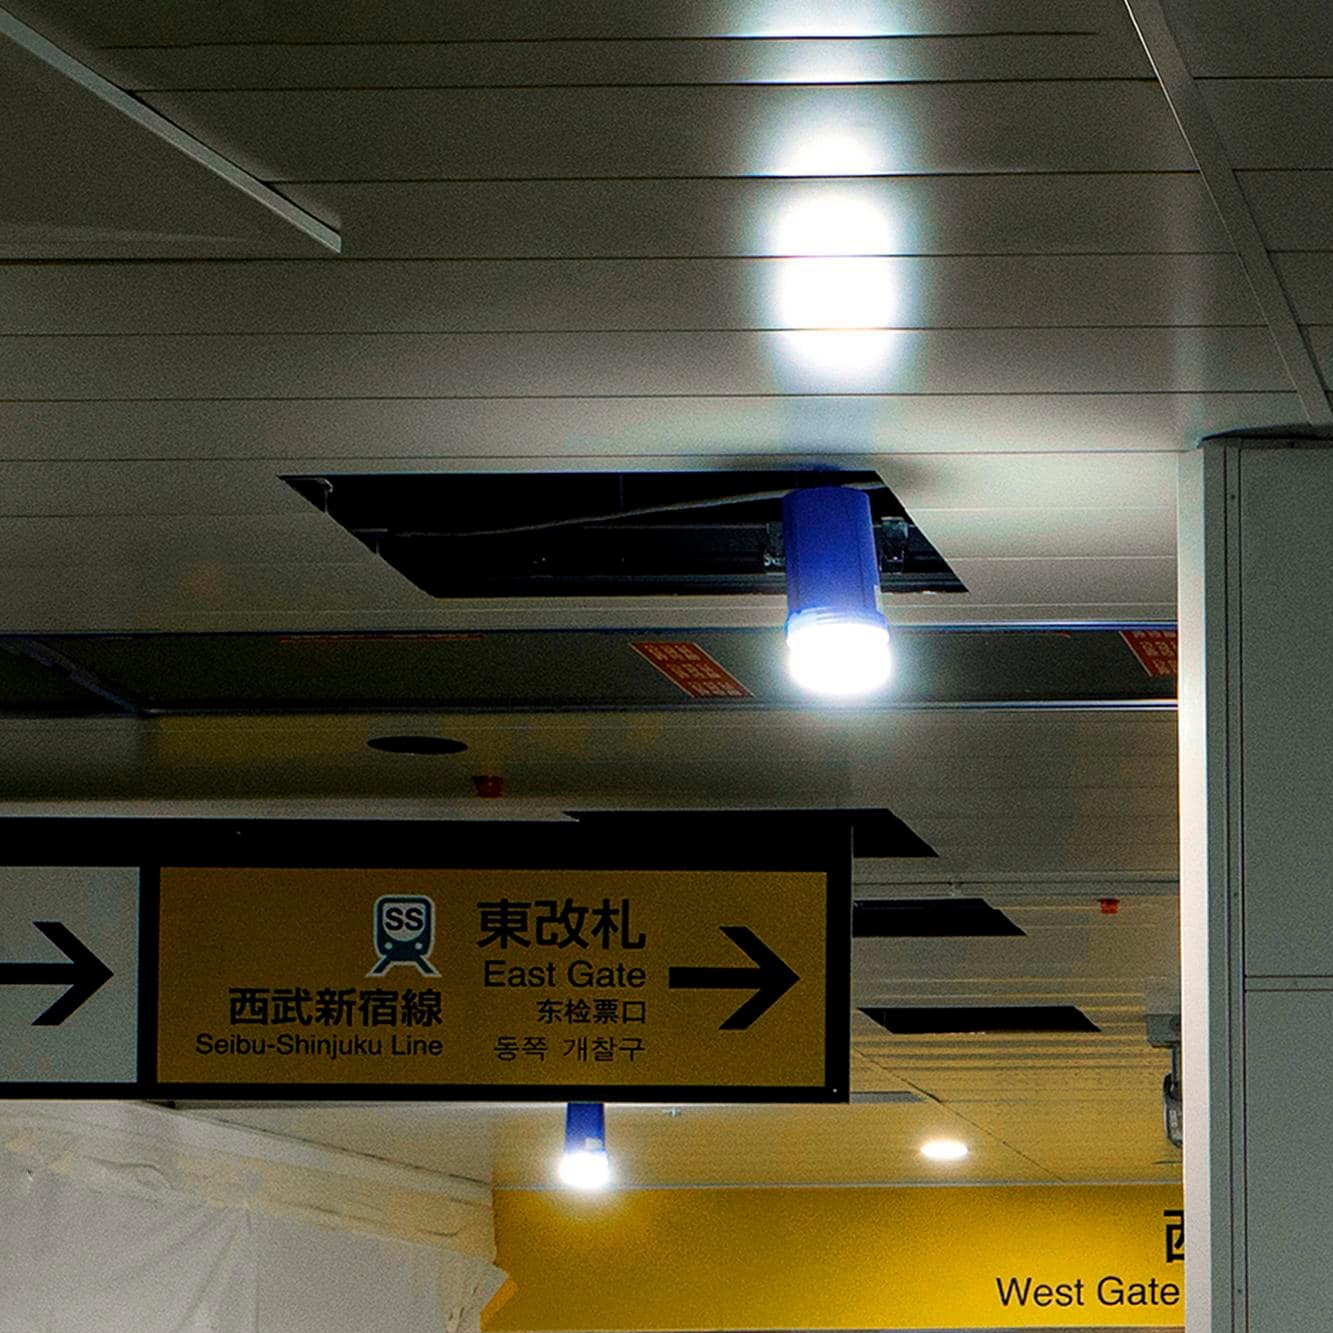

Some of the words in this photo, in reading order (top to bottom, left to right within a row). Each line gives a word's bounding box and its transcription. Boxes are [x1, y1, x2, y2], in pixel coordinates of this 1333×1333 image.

[385, 907, 424, 931] SS
[477, 899, 646, 949] 東改札
[484, 960, 556, 988] East
[567, 960, 646, 988] Gate
[229, 988, 442, 1027] 西武新宿線
[537, 999, 646, 1024] 东检票口
[195, 1033, 382, 1059] Seibu-Shinjuku
[391, 1035, 443, 1056] Line
[494, 1036, 548, 1061] 동쪽
[563, 1036, 645, 1061] 개찰구
[996, 1277, 1085, 1307] West
[1097, 1276, 1180, 1306] Gate
